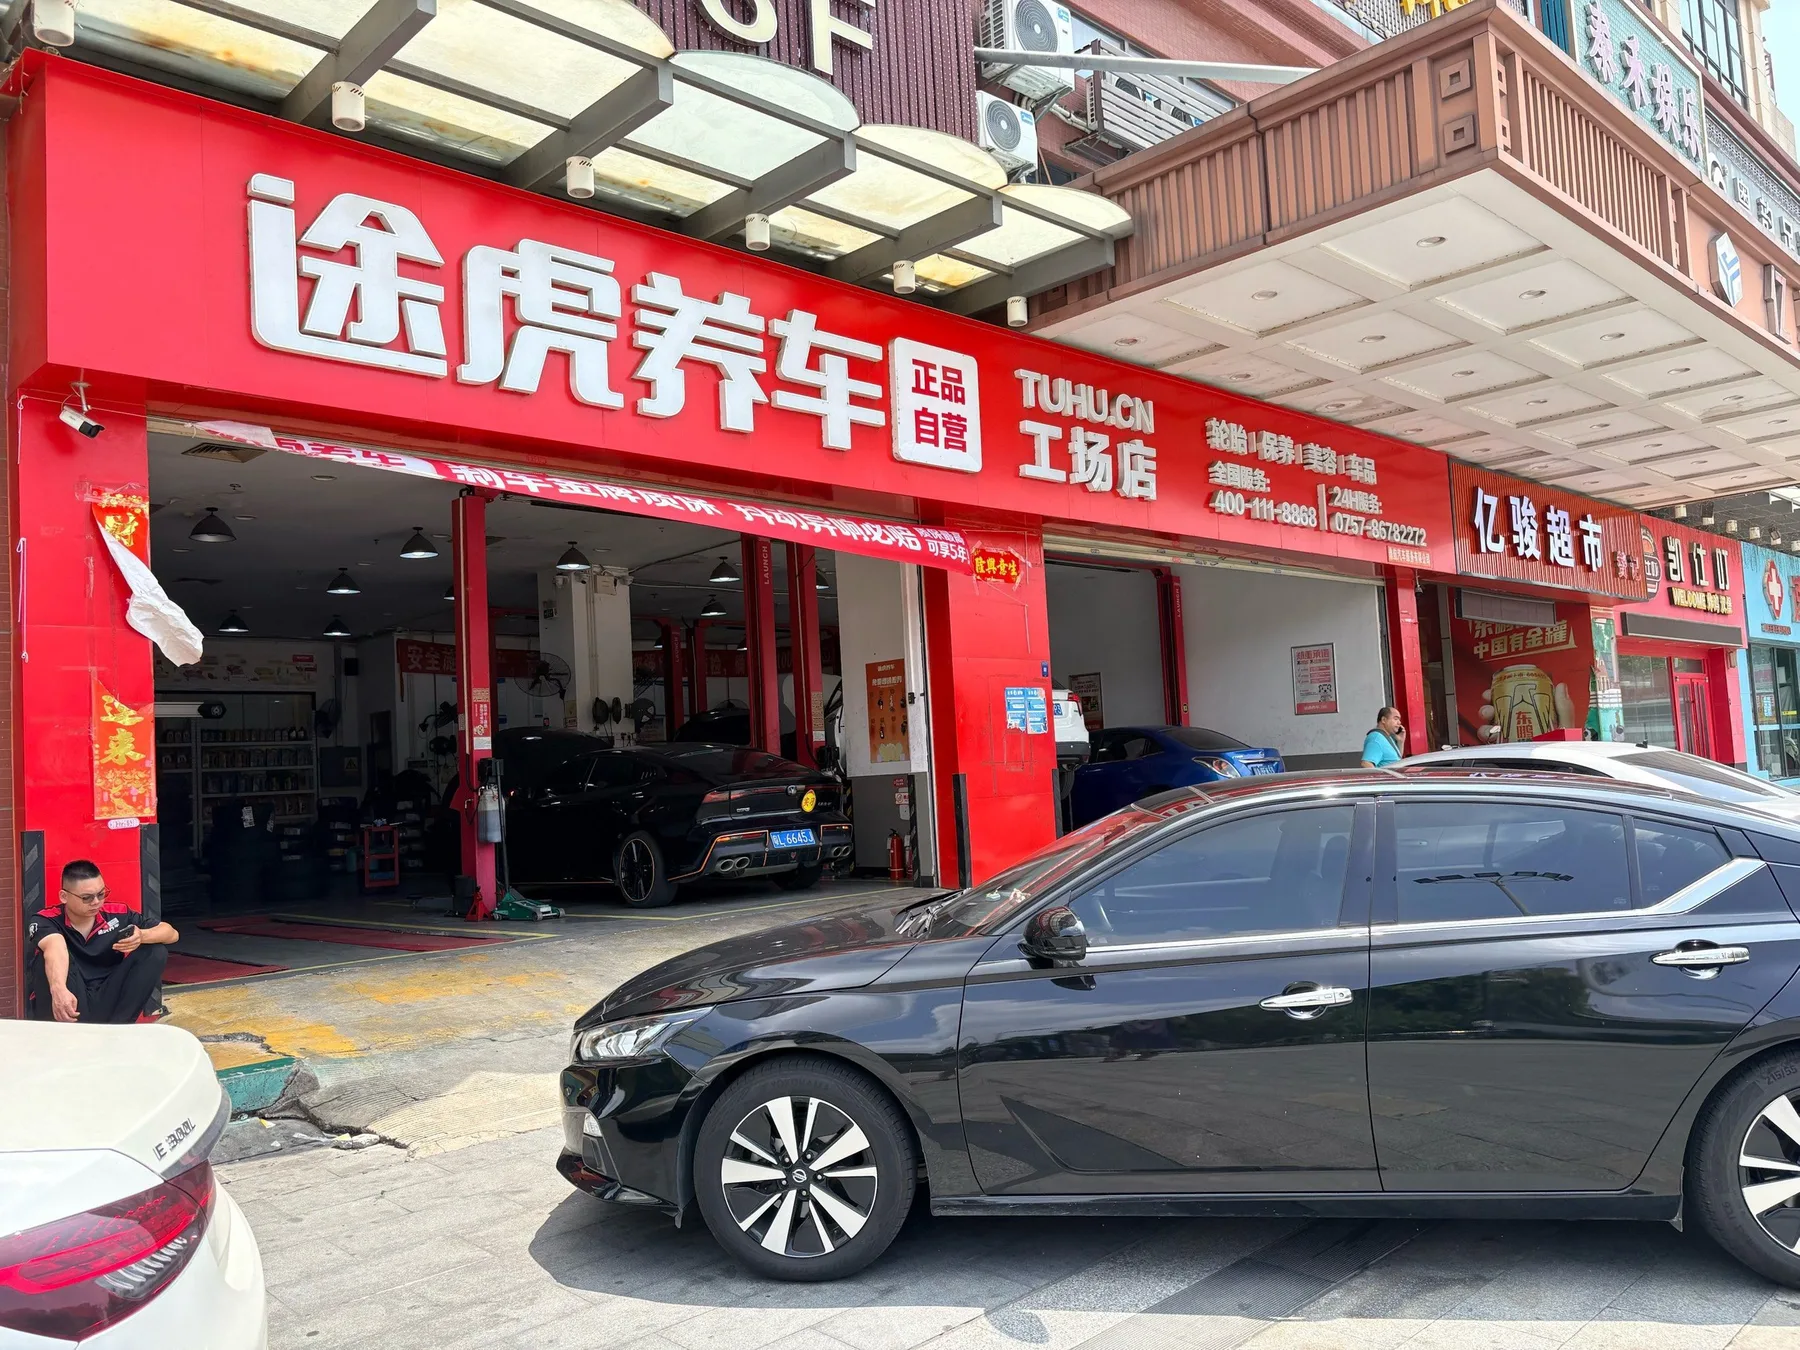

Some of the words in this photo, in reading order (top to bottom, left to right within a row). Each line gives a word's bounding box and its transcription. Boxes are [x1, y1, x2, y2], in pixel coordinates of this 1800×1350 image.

[248, 173, 885, 450] 途虎养车
[911, 358, 966, 406] 正品
[1014, 368, 1155, 434] TUHU.CN
[914, 406, 967, 453] 自营
[1019, 419, 1157, 501] 工场店
[448, 463, 723, 515] 刹车金牌质保
[727, 503, 922, 551] 抖动异响必赔
[1209, 489, 1318, 529] 400-111-8868
[1330, 511, 1428, 547] 0757-86782272
[1473, 486, 1604, 573] 亿骏超市
[1669, 587, 1707, 610] WELCOME
[1473, 620, 1568, 659] 中国有金罐
[1764, 1064, 1798, 1086] 215/55
[152, 1142, 168, 1161] E
